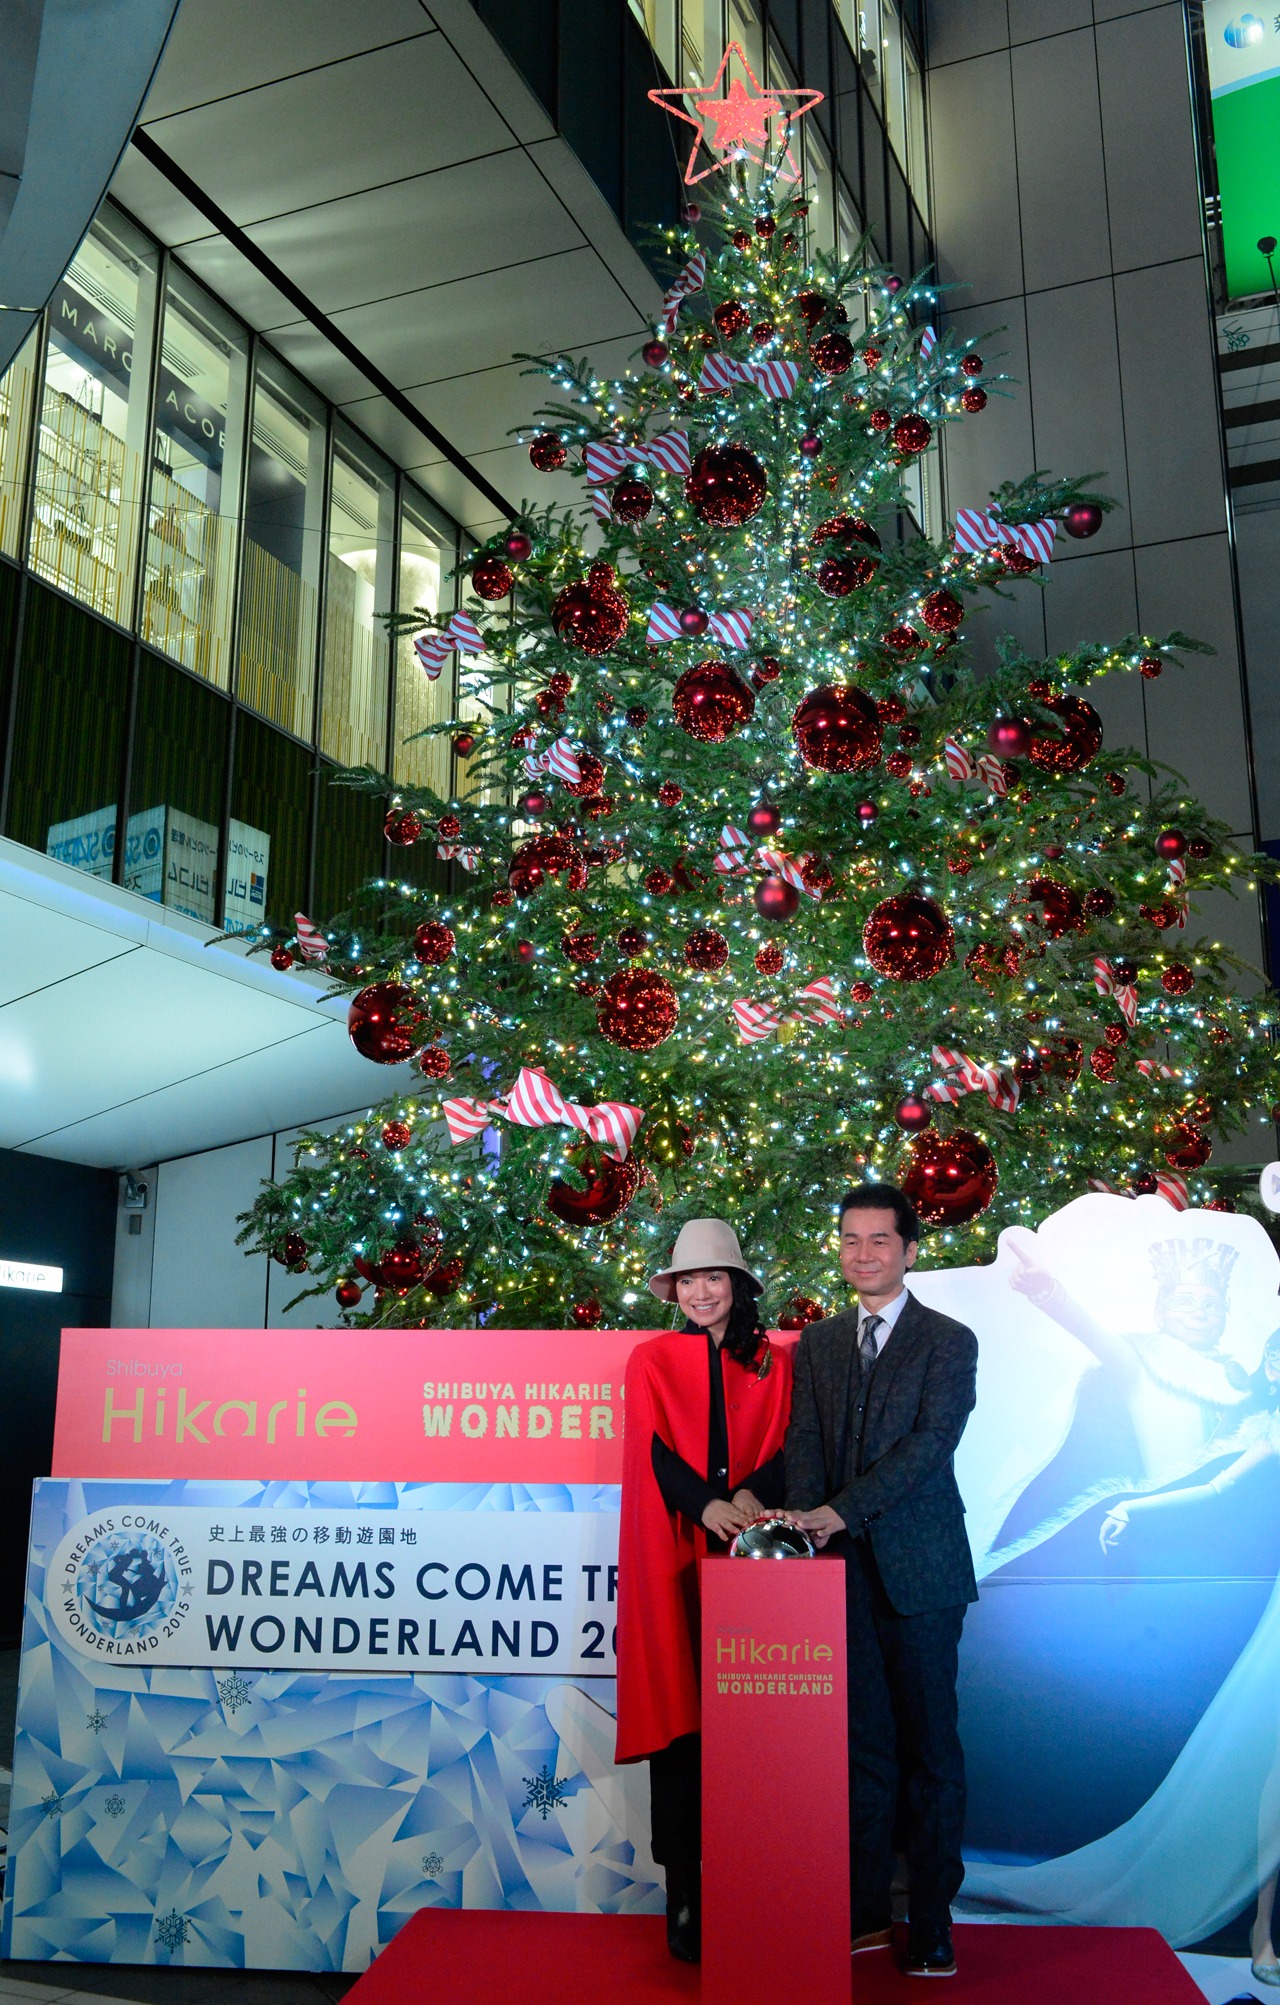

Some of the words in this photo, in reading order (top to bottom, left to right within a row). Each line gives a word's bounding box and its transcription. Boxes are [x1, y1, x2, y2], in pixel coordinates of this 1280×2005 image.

[61, 299, 133, 373] MARC
[0, 1265, 46, 1284] ikarie
[106, 1359, 184, 1379] Shibuya
[423, 1382, 517, 1400] SHIBUYA
[524, 1383, 613, 1400] HIKARIE
[102, 1387, 358, 1444] Hikarie
[422, 1404, 625, 1439] WONDER
[65, 1519, 115, 1574] DREAMS
[121, 1515, 170, 1540] COME
[169, 1537, 193, 1576] TRUE
[208, 1524, 418, 1545] 史上最強の移動遊園地
[206, 1559, 396, 1599] DREAMS
[416, 1562, 563, 1601] COME
[63, 1598, 159, 1655] WONDERLAND
[162, 1601, 190, 1638] 2015
[205, 1614, 559, 1658] WONDERLAND
[580, 1620, 618, 1659] 2
[716, 1638, 833, 1664] Hikarie
[716, 1673, 751, 1681] SHIBUYA
[753, 1673, 786, 1681] HIKARIE
[788, 1674, 833, 1682] CHRISTMAS
[716, 1681, 833, 1695] WONDERLAND
